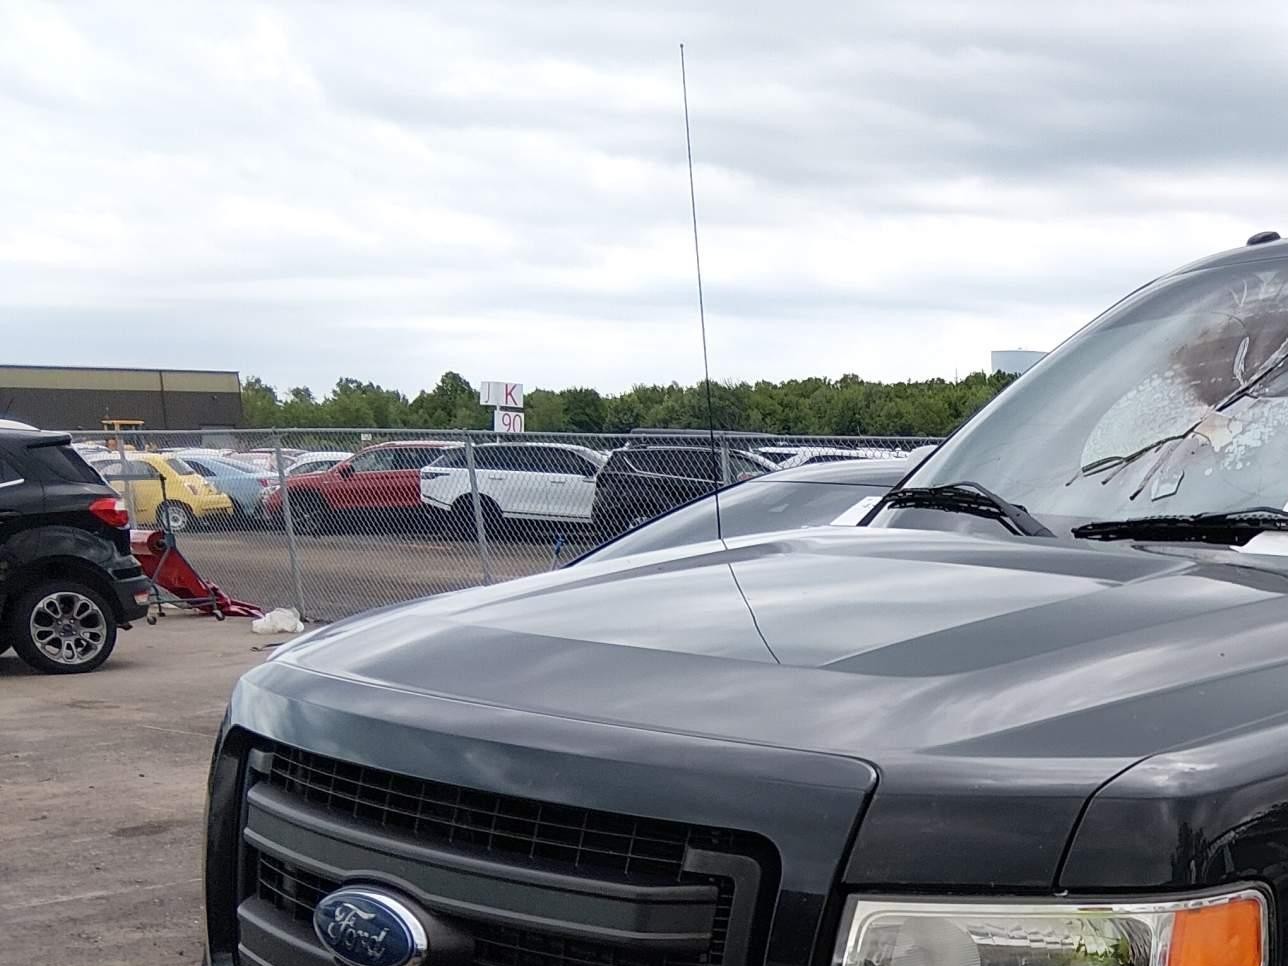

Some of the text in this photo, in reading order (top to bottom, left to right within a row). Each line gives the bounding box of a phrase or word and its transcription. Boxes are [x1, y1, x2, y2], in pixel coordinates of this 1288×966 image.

[505, 383, 518, 406] K
[501, 412, 523, 432] 90
[328, 902, 391, 959] Ford
